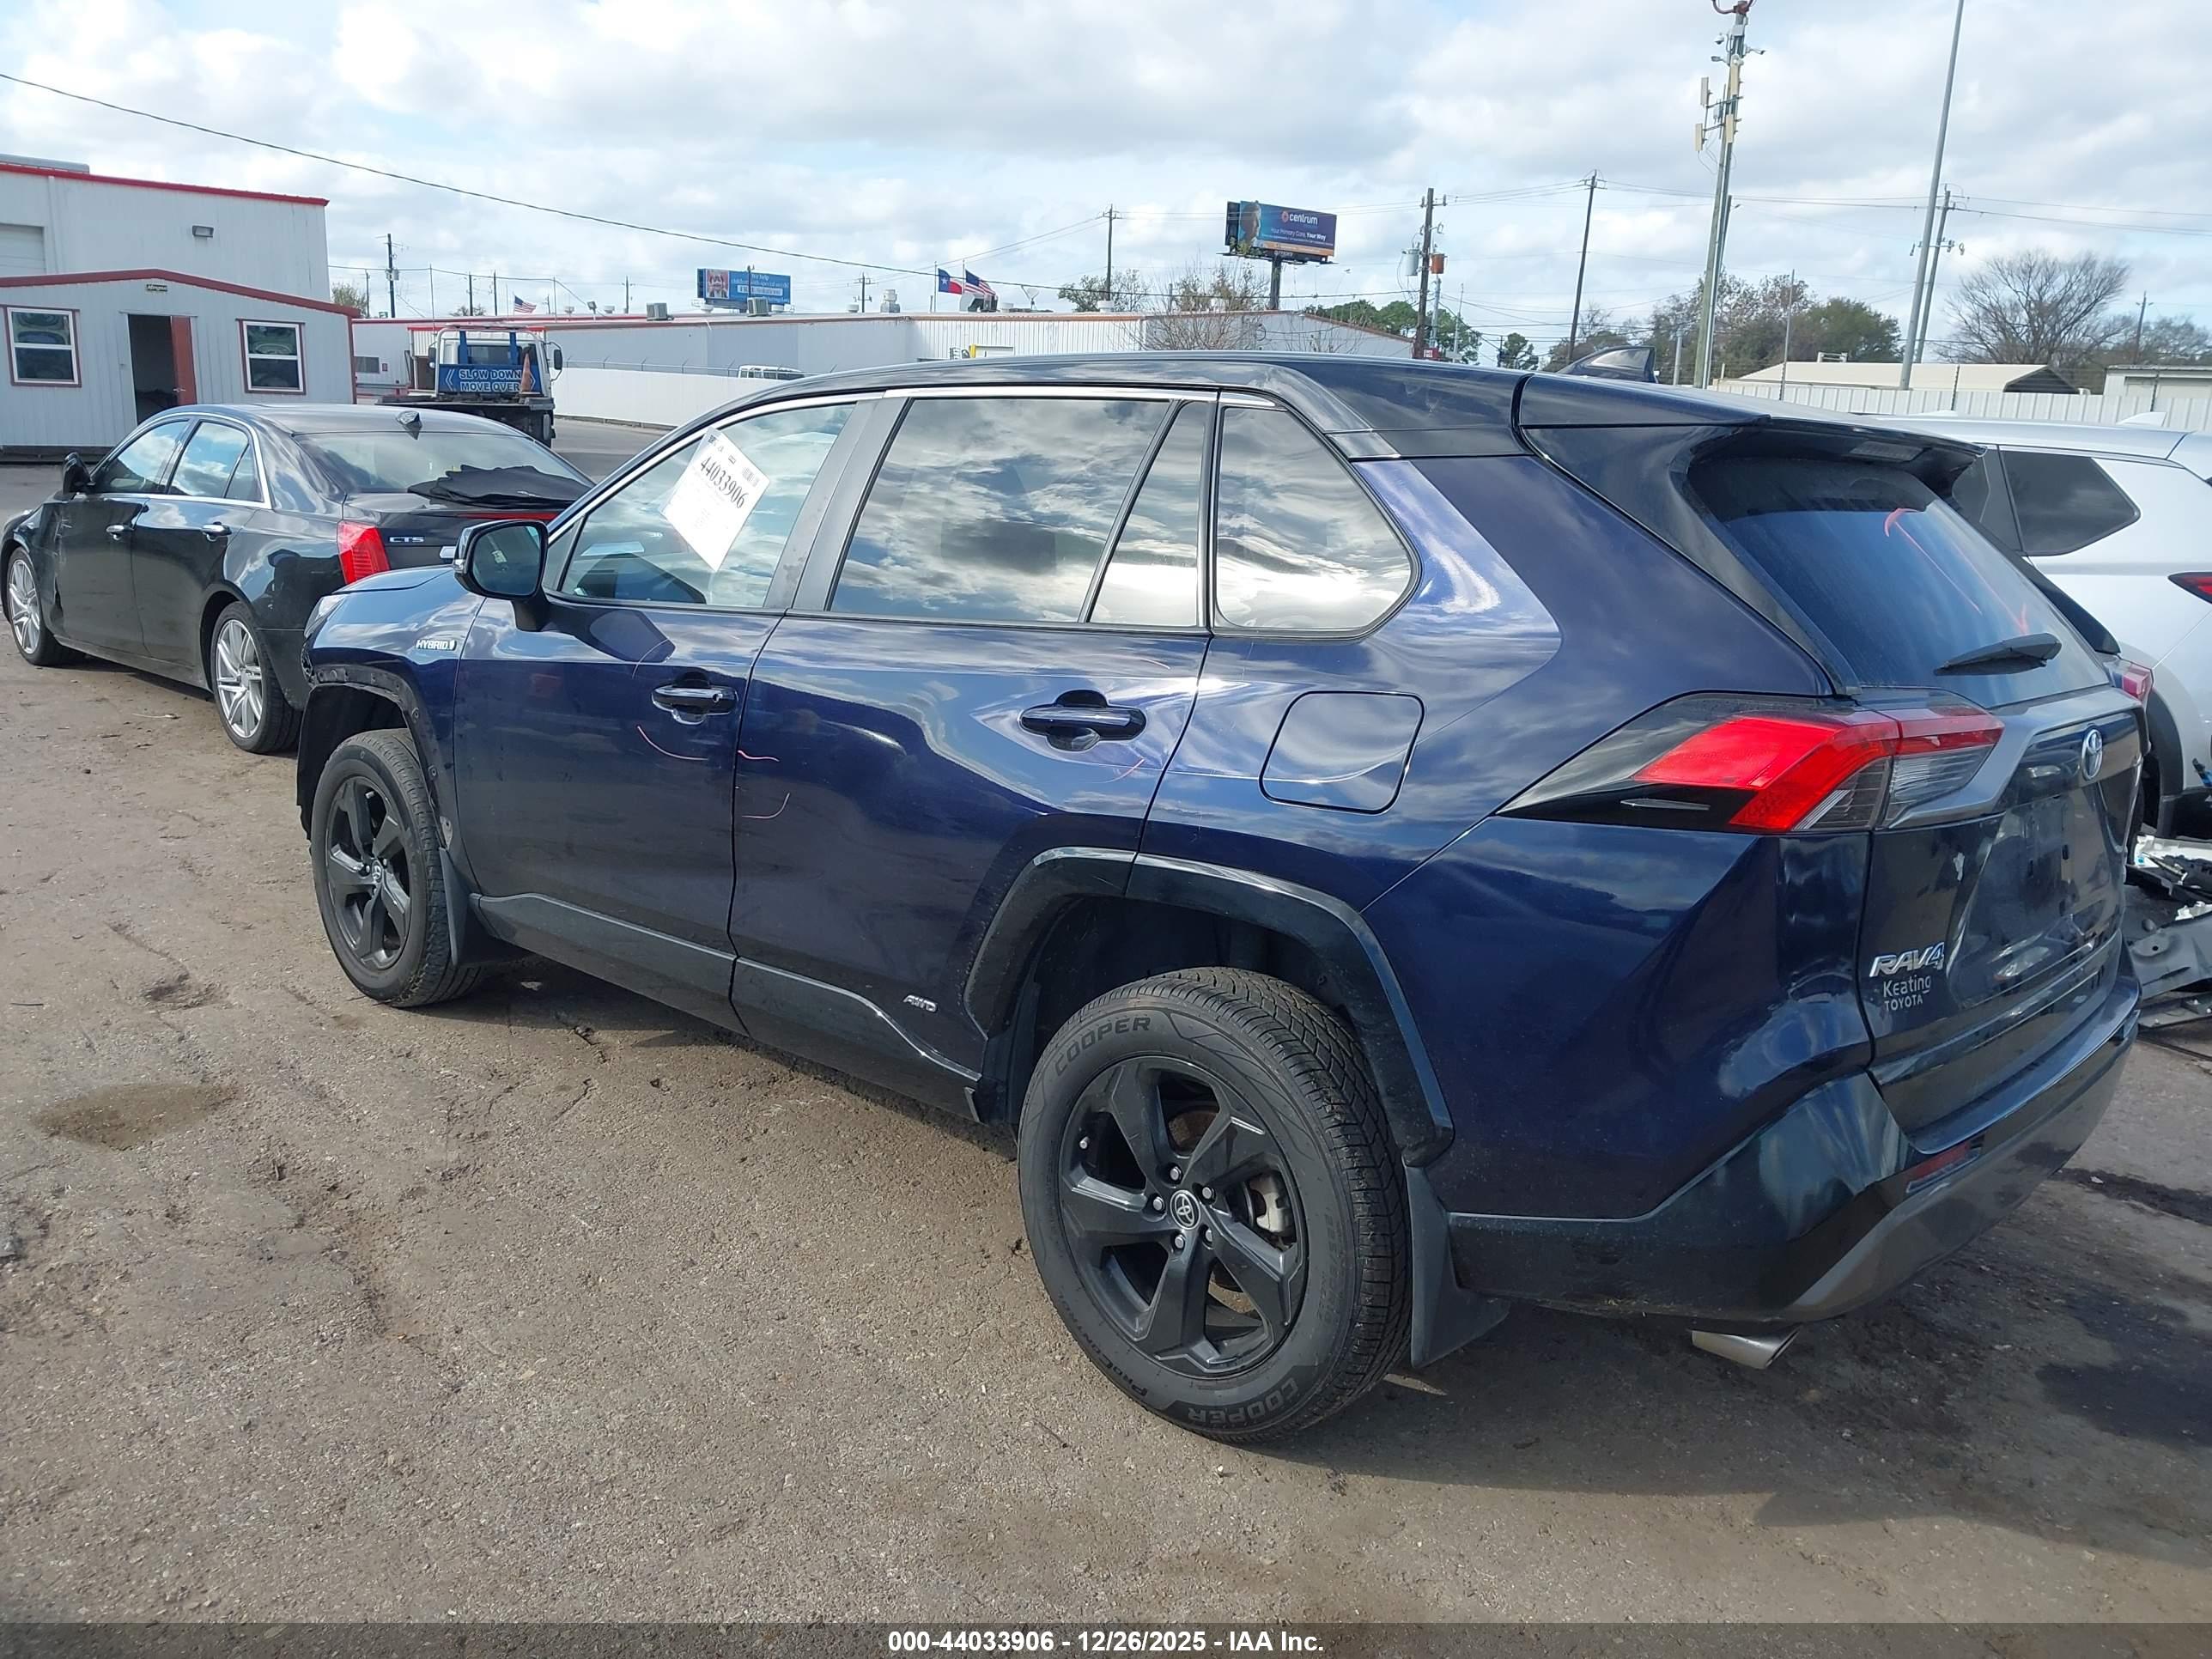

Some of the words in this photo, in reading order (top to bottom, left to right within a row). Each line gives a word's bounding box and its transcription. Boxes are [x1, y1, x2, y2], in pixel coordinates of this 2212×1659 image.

[1289, 212, 1318, 225] centrum
[459, 369, 489, 380] SLOW
[491, 369, 522, 380] DOWN
[460, 382, 490, 392] MOVE
[492, 382, 520, 392] OVER
[700, 456, 750, 509] 44033906
[416, 640, 448, 650] HYBRID
[1869, 941, 1945, 978] RAV4
[1882, 974, 1932, 997] Keating
[1884, 994, 1923, 1012] TOYOTA
[1054, 1017, 1152, 1077] COOPER
[1188, 1376, 1299, 1425] COOPER
